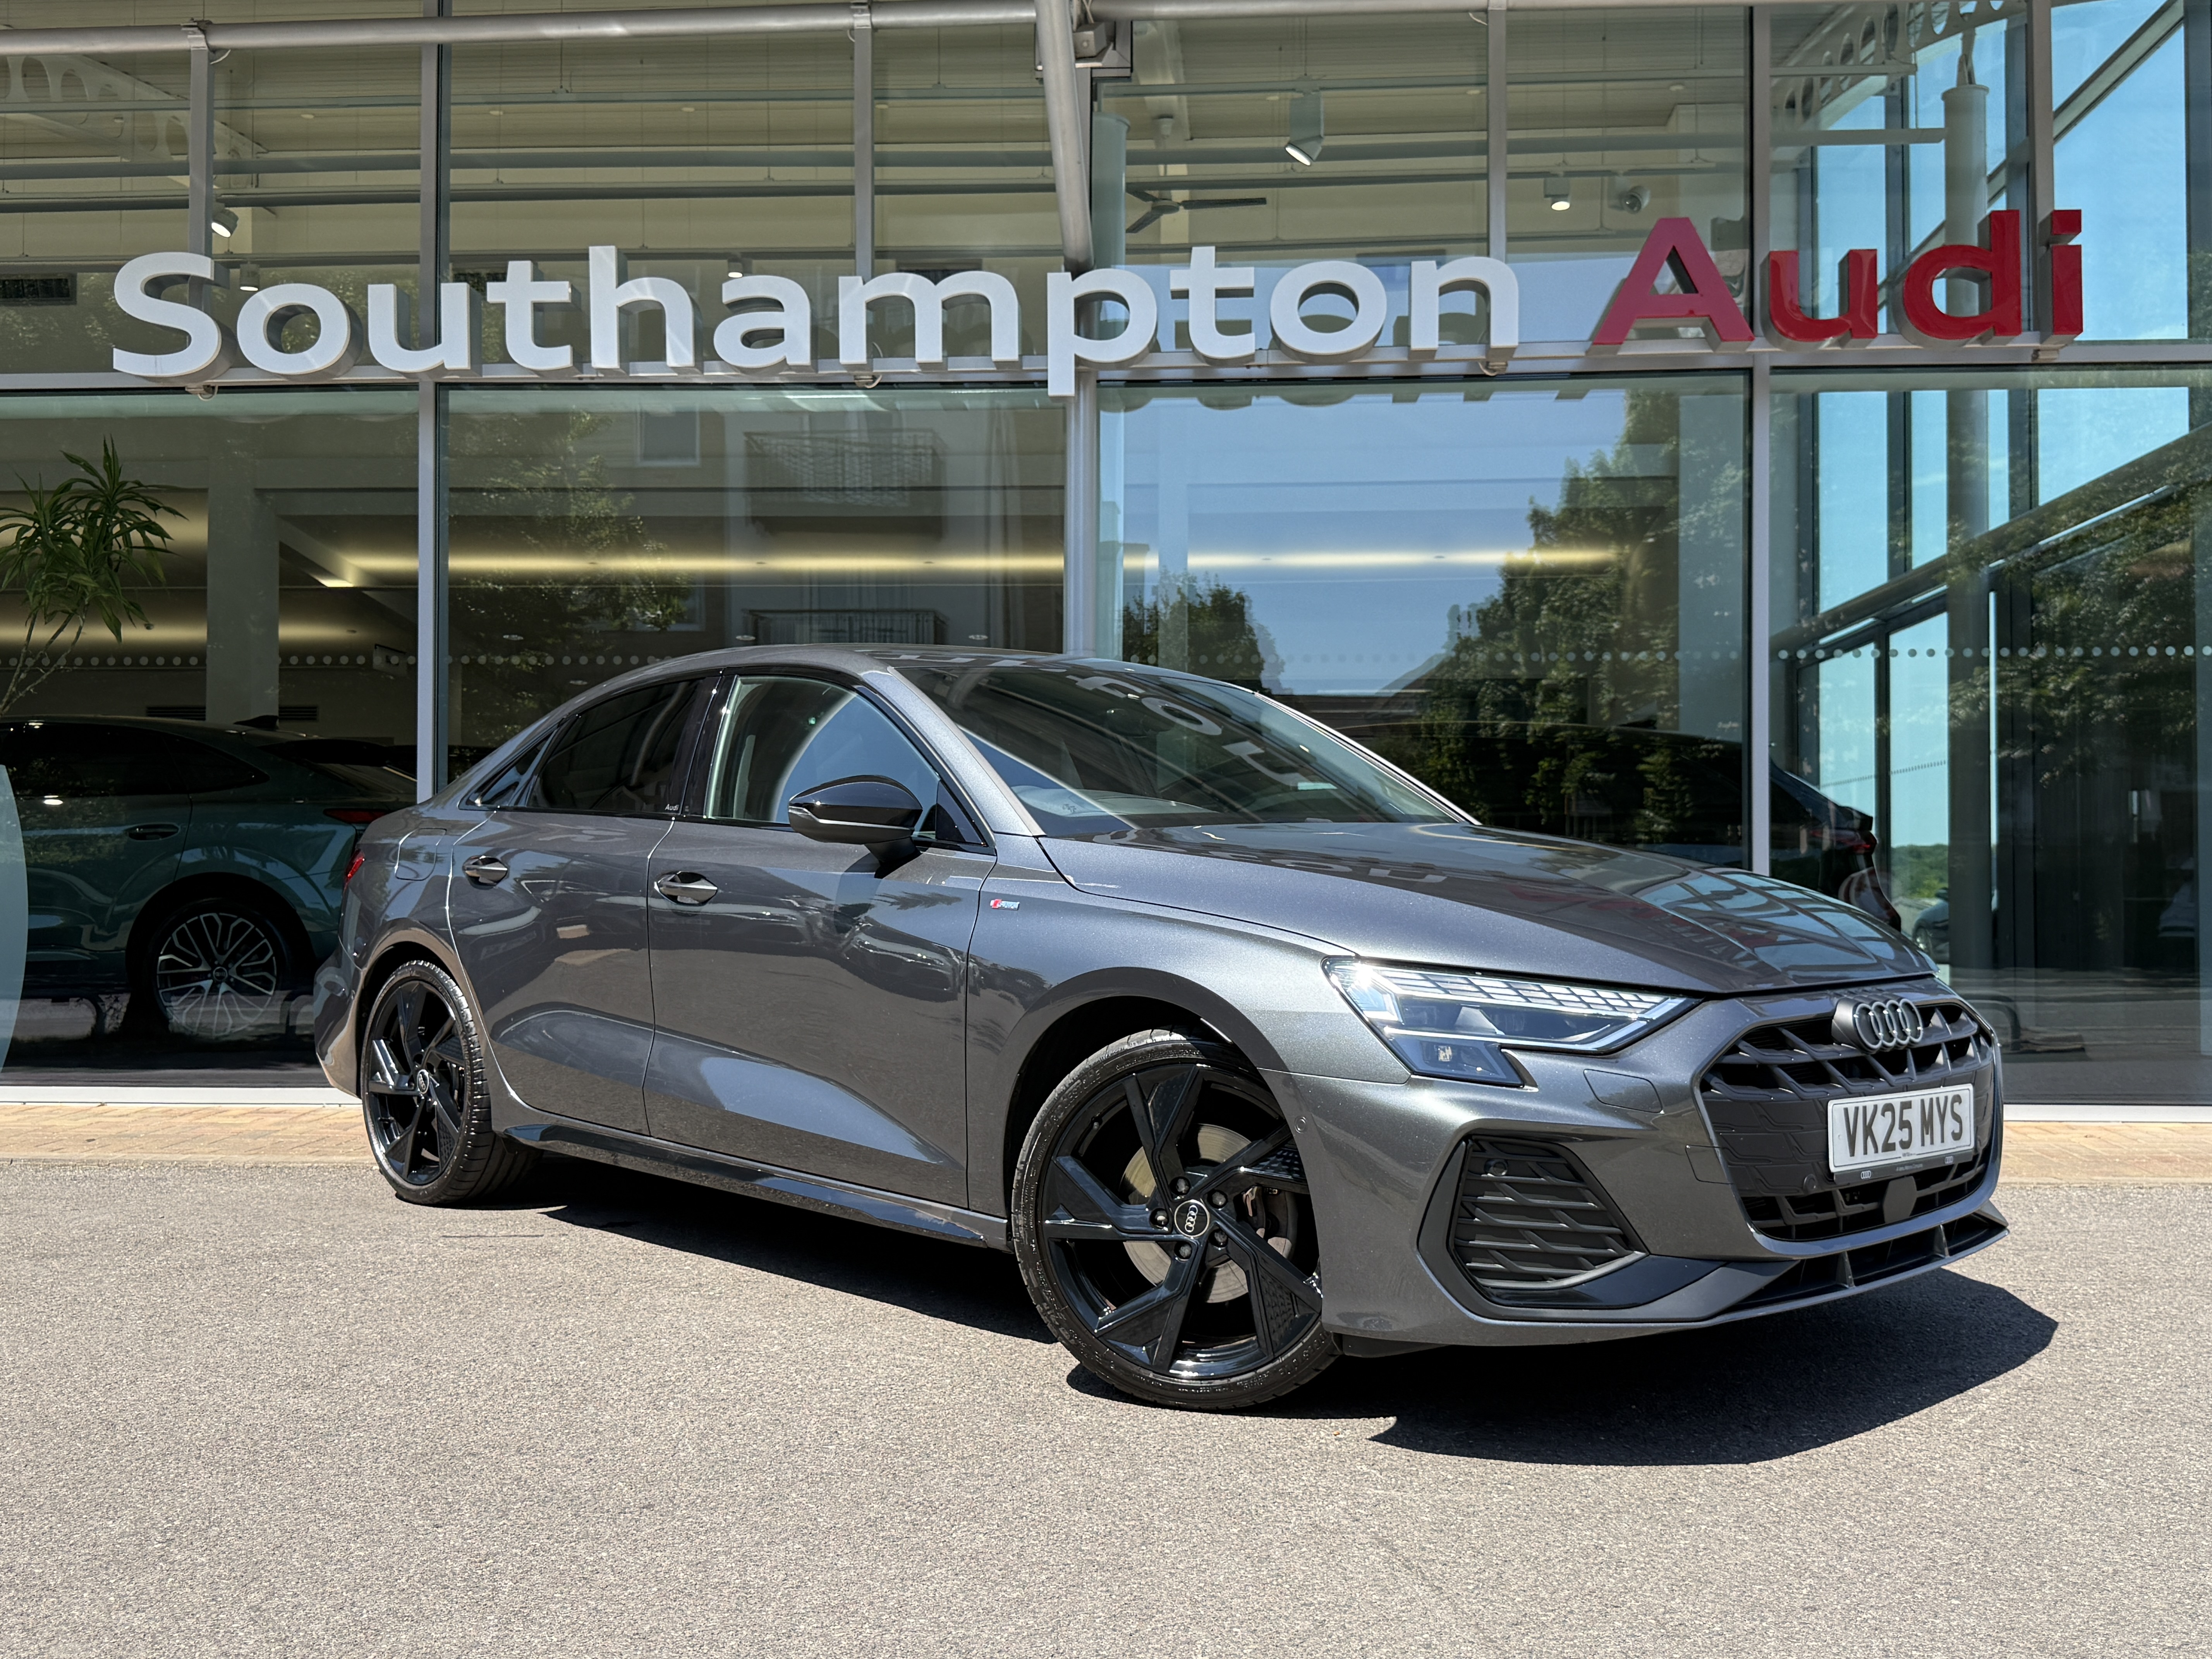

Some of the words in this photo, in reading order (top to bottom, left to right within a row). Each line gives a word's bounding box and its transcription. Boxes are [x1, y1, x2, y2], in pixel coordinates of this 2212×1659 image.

[112, 245, 1519, 397] Southampton
[1592, 209, 2083, 342] Audi
[1843, 1100, 1912, 1157] VK25
[1920, 1094, 1963, 1147] MYS
